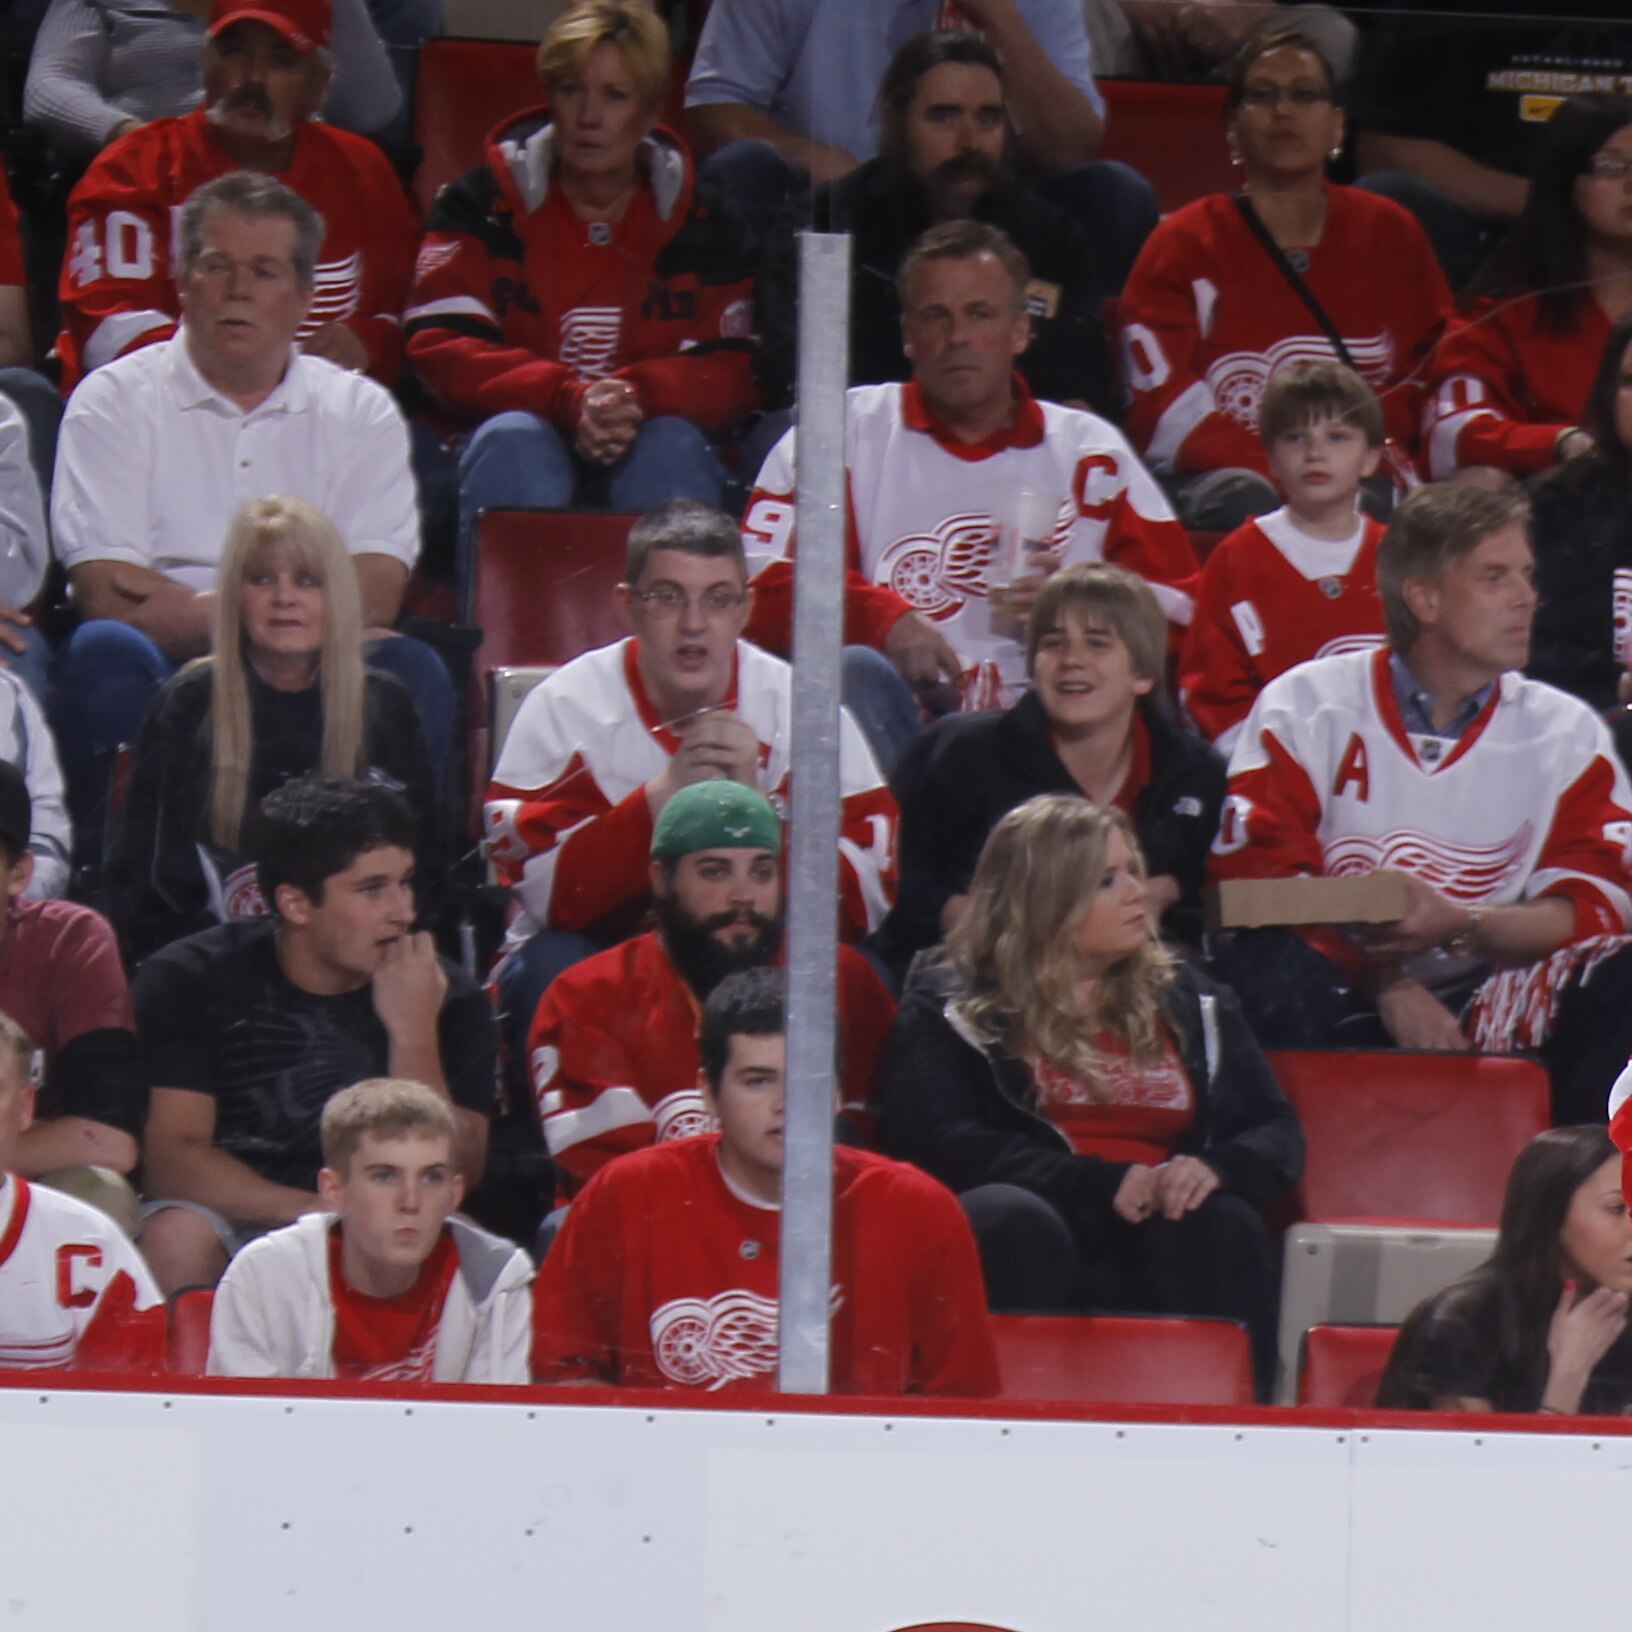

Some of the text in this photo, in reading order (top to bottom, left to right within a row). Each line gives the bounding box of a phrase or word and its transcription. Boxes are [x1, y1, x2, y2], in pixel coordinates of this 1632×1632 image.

[1487, 71, 1614, 95] MICHIGAN
[1071, 454, 1118, 521] C
[1333, 732, 1369, 804] A
[55, 1244, 103, 1309] C
